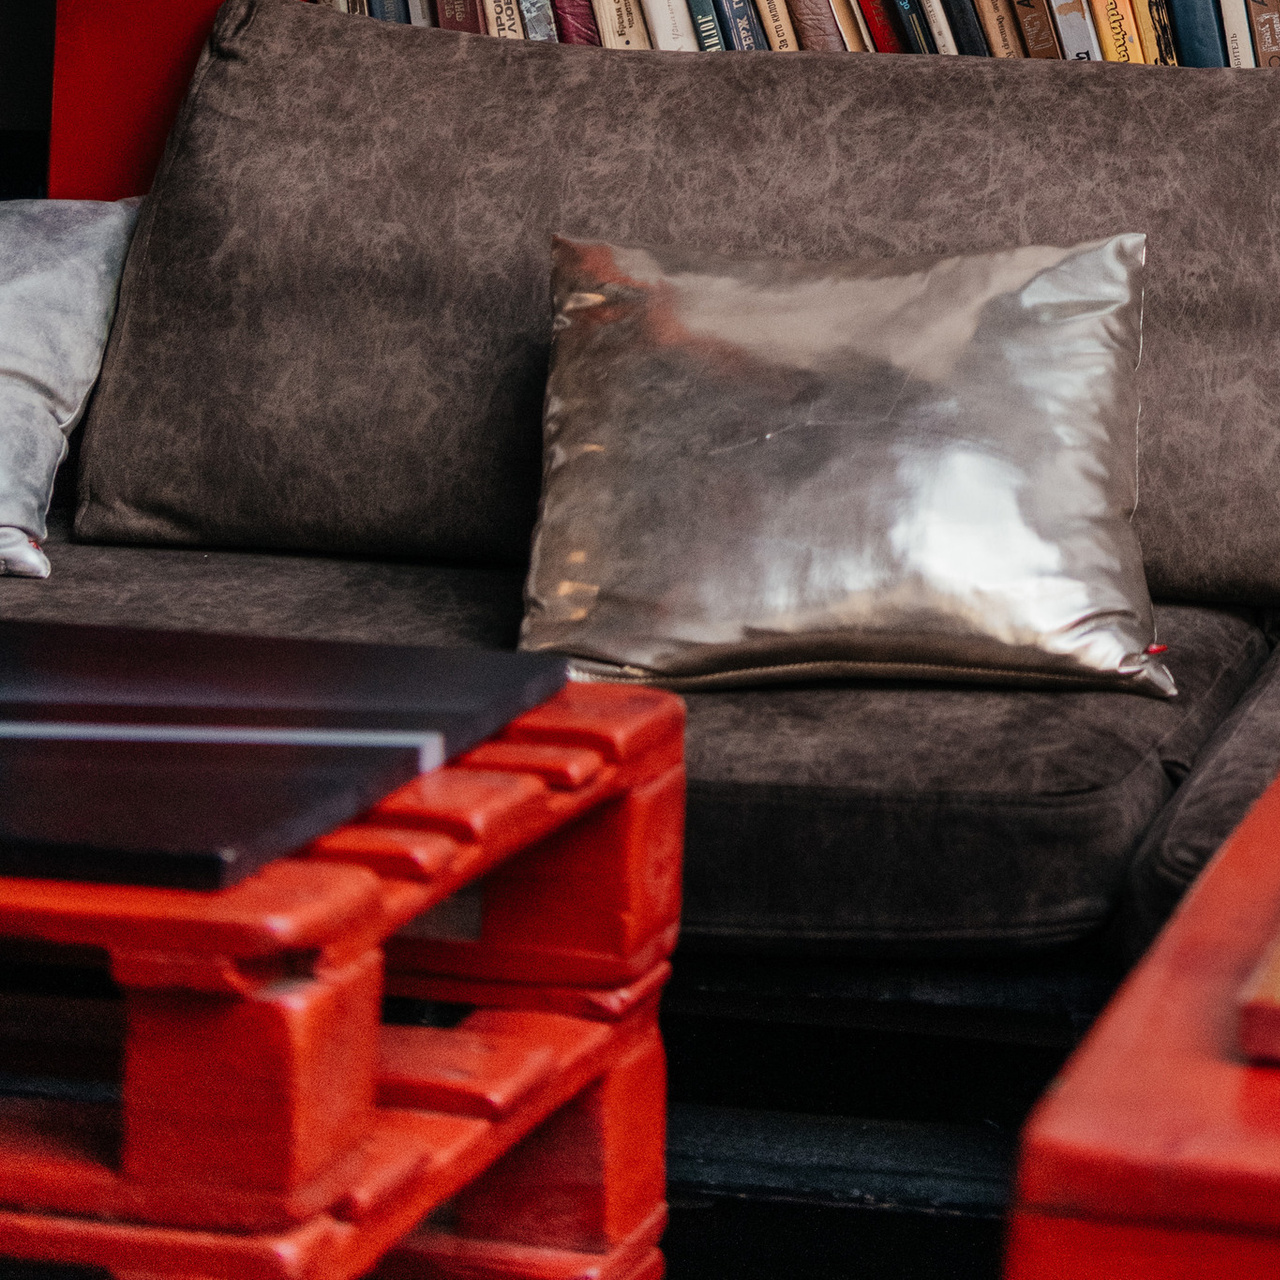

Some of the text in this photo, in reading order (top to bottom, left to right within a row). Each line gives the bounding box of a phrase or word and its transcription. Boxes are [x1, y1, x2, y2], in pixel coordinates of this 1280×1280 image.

[615, 7, 627, 37] Бремя
[774, 22, 784, 37] сто
[779, 38, 789, 50] За
